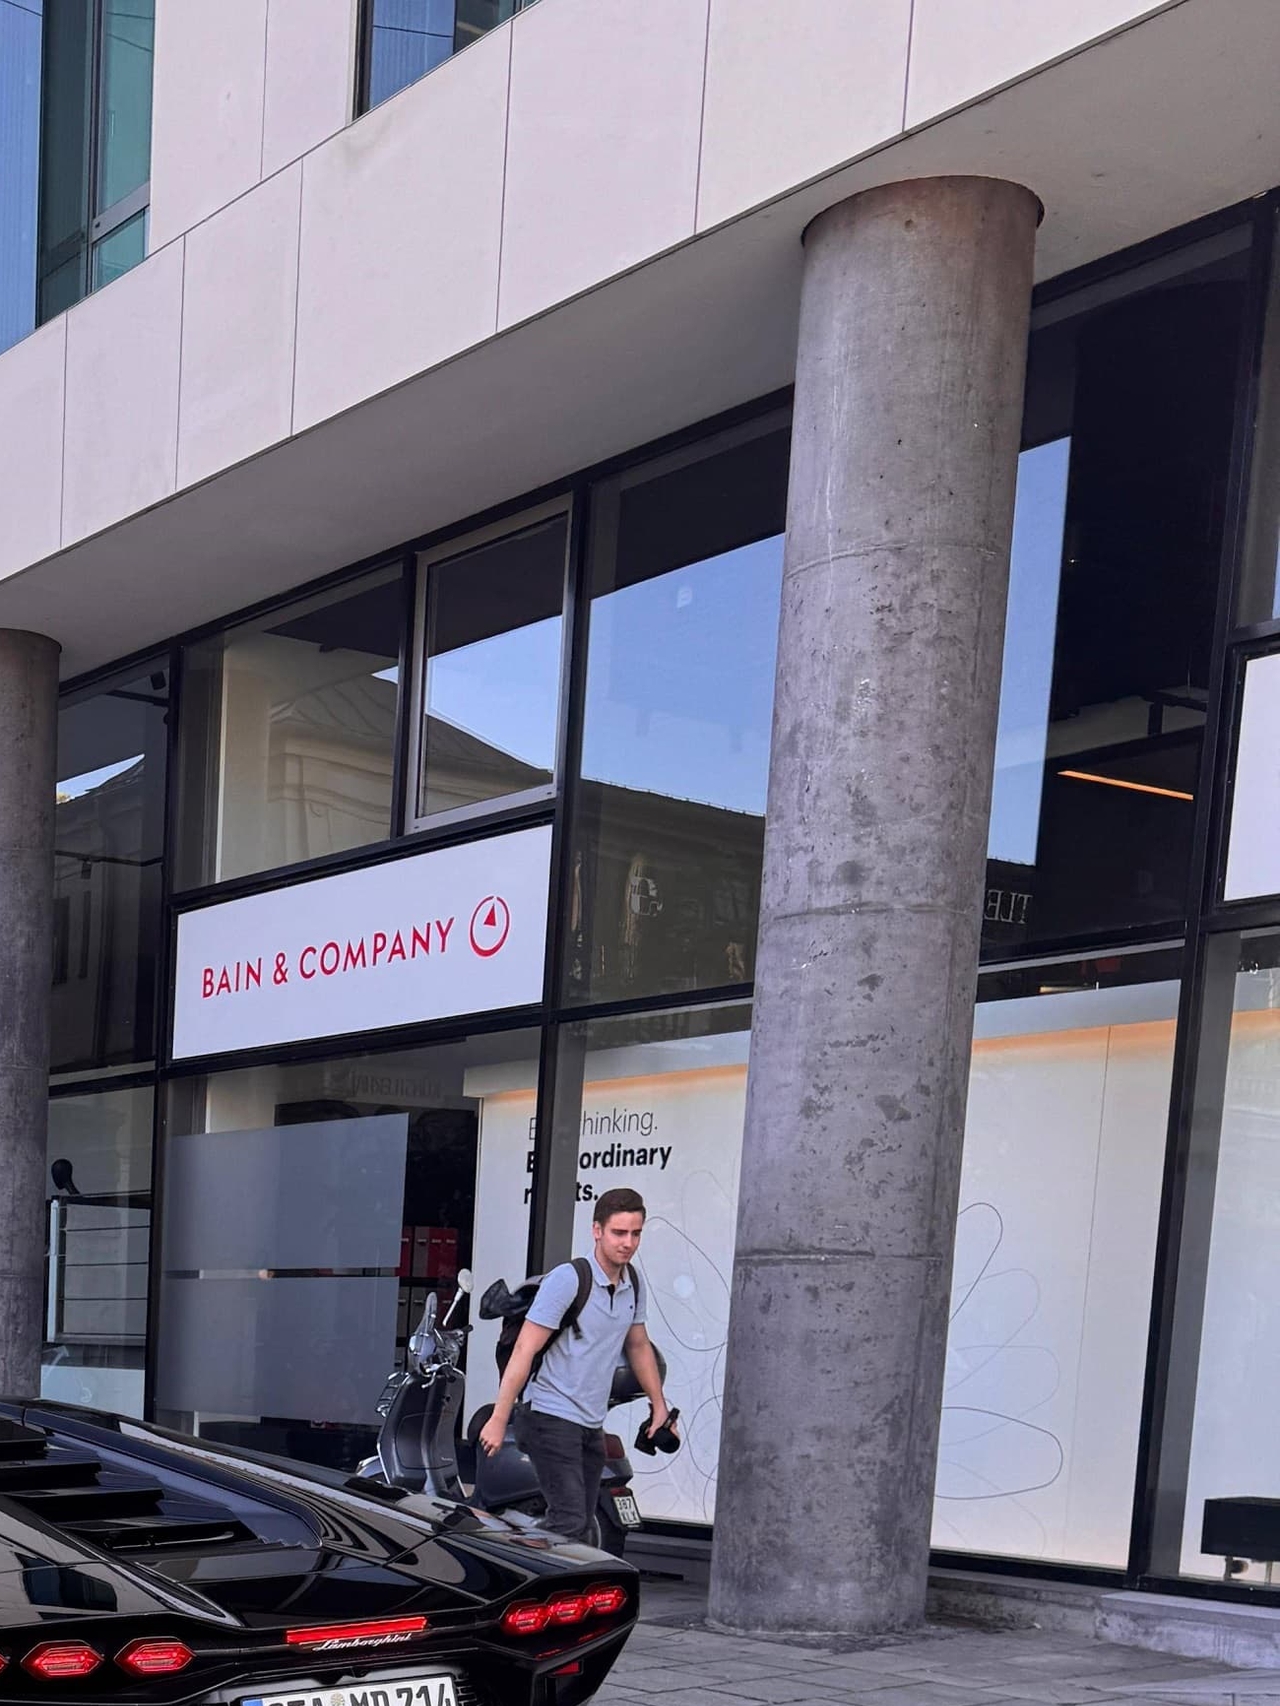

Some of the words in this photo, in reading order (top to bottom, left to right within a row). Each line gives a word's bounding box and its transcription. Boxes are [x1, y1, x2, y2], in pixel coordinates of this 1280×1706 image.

[202, 957, 262, 998] BAIN
[272, 952, 288, 985] &
[299, 917, 455, 979] COMPANY
[312, 1633, 412, 1651] Lamborghini
